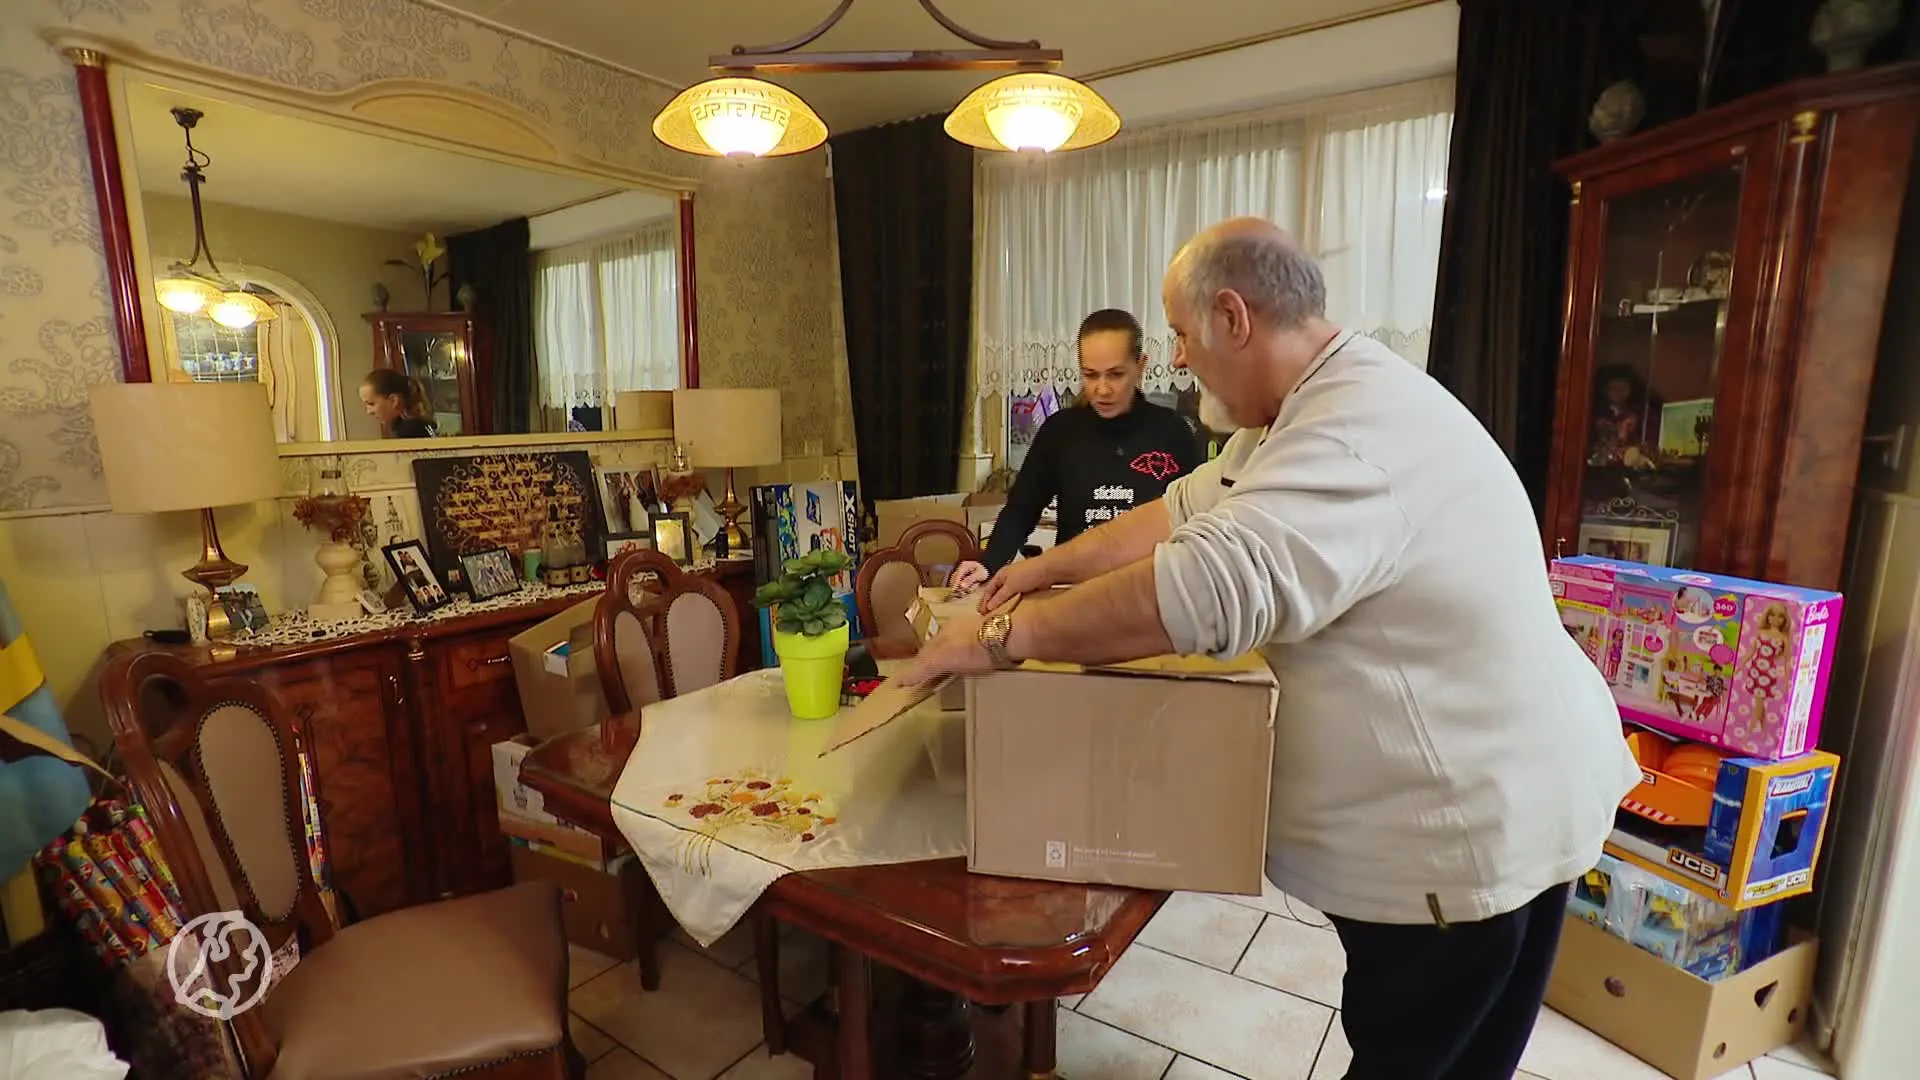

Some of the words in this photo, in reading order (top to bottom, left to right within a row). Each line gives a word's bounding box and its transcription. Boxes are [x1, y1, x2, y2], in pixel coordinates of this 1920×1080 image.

[1093, 485, 1134, 503] stichting
[1085, 505, 1112, 523] gratis
[1671, 852, 1716, 878] JCB
